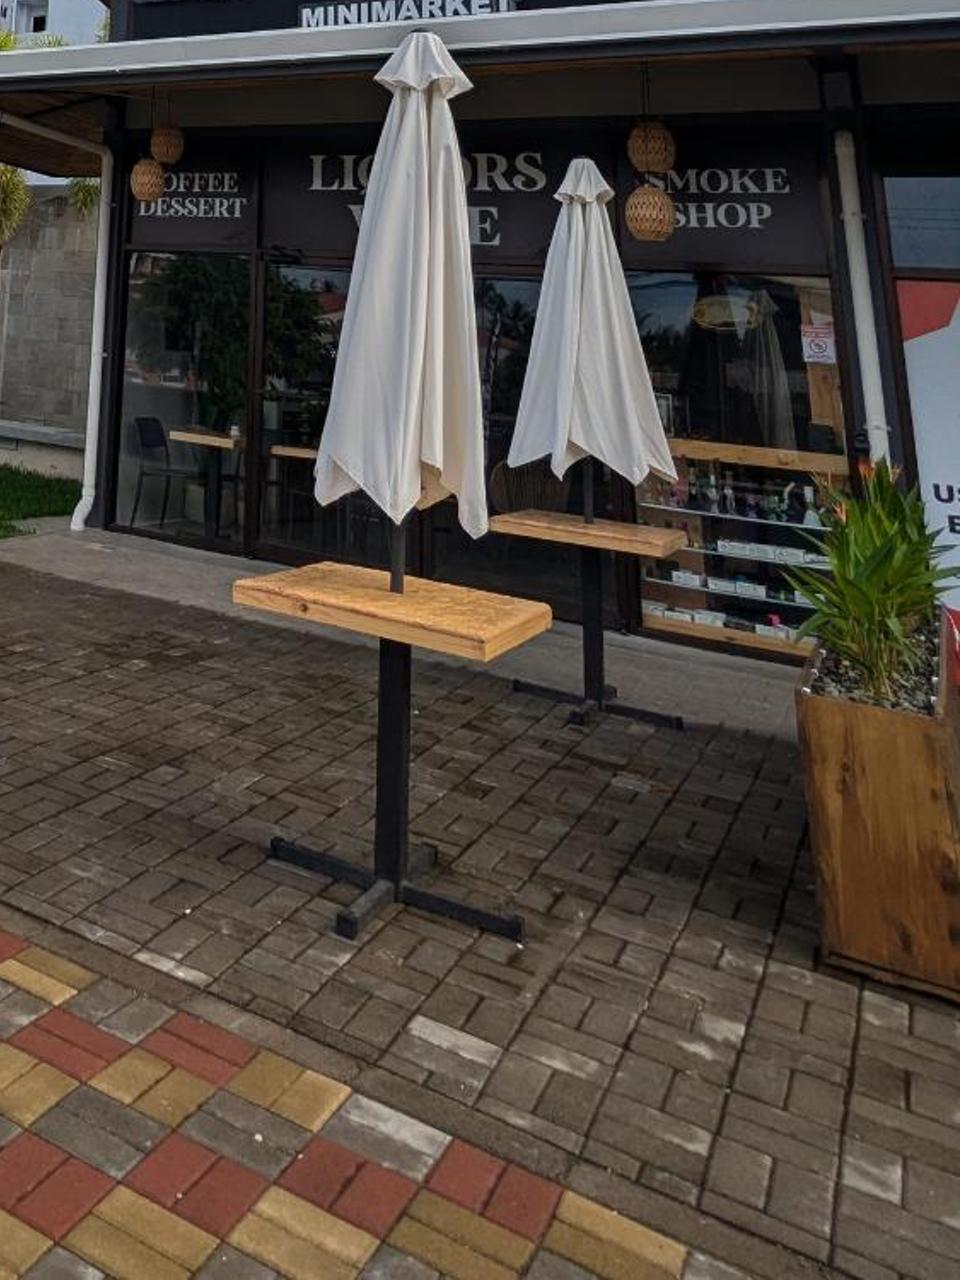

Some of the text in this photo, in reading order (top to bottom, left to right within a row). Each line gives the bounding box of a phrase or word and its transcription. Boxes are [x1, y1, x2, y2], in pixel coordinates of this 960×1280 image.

[162, 171, 239, 193] OFFEE
[309, 152, 547, 195] LIRS
[138, 197, 247, 218] DESSERT
